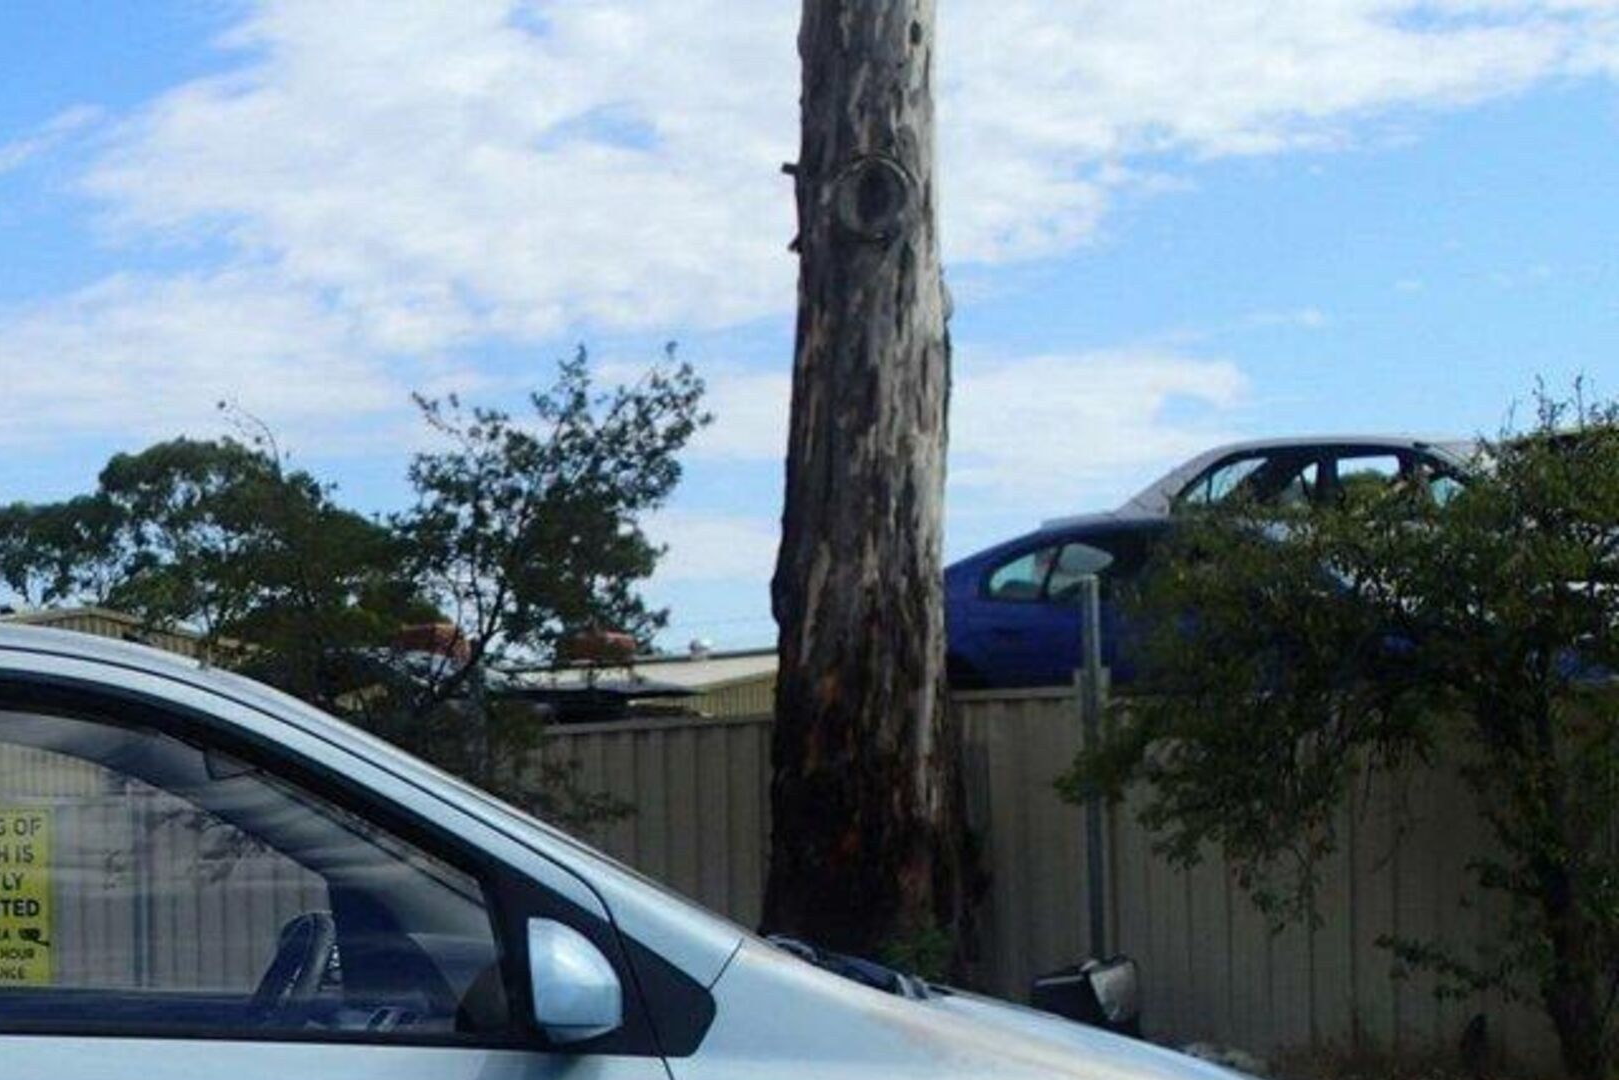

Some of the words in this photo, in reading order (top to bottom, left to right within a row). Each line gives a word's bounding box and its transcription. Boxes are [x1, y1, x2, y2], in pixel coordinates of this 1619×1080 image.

[13, 818, 42, 836] OF
[17, 845, 35, 863] IS
[1, 948, 35, 959] HOUR
